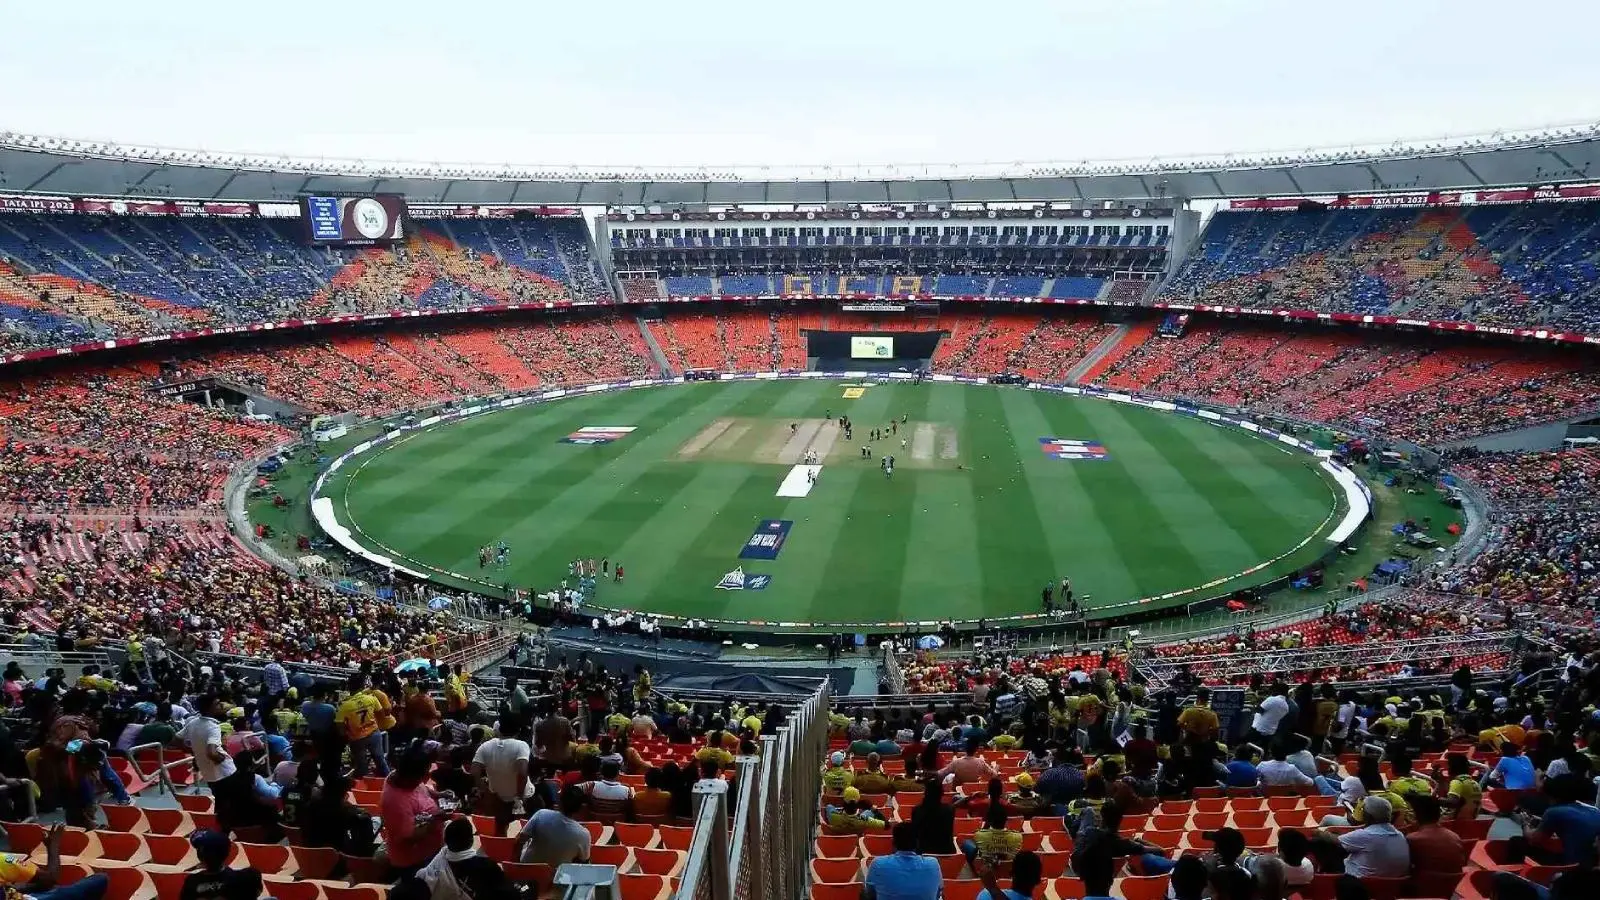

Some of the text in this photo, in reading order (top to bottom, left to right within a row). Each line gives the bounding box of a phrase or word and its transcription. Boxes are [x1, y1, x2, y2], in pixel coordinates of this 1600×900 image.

[1407, 196, 1428, 204] 2023
[49, 201, 75, 209] 2023
[179, 383, 196, 393] 2023
